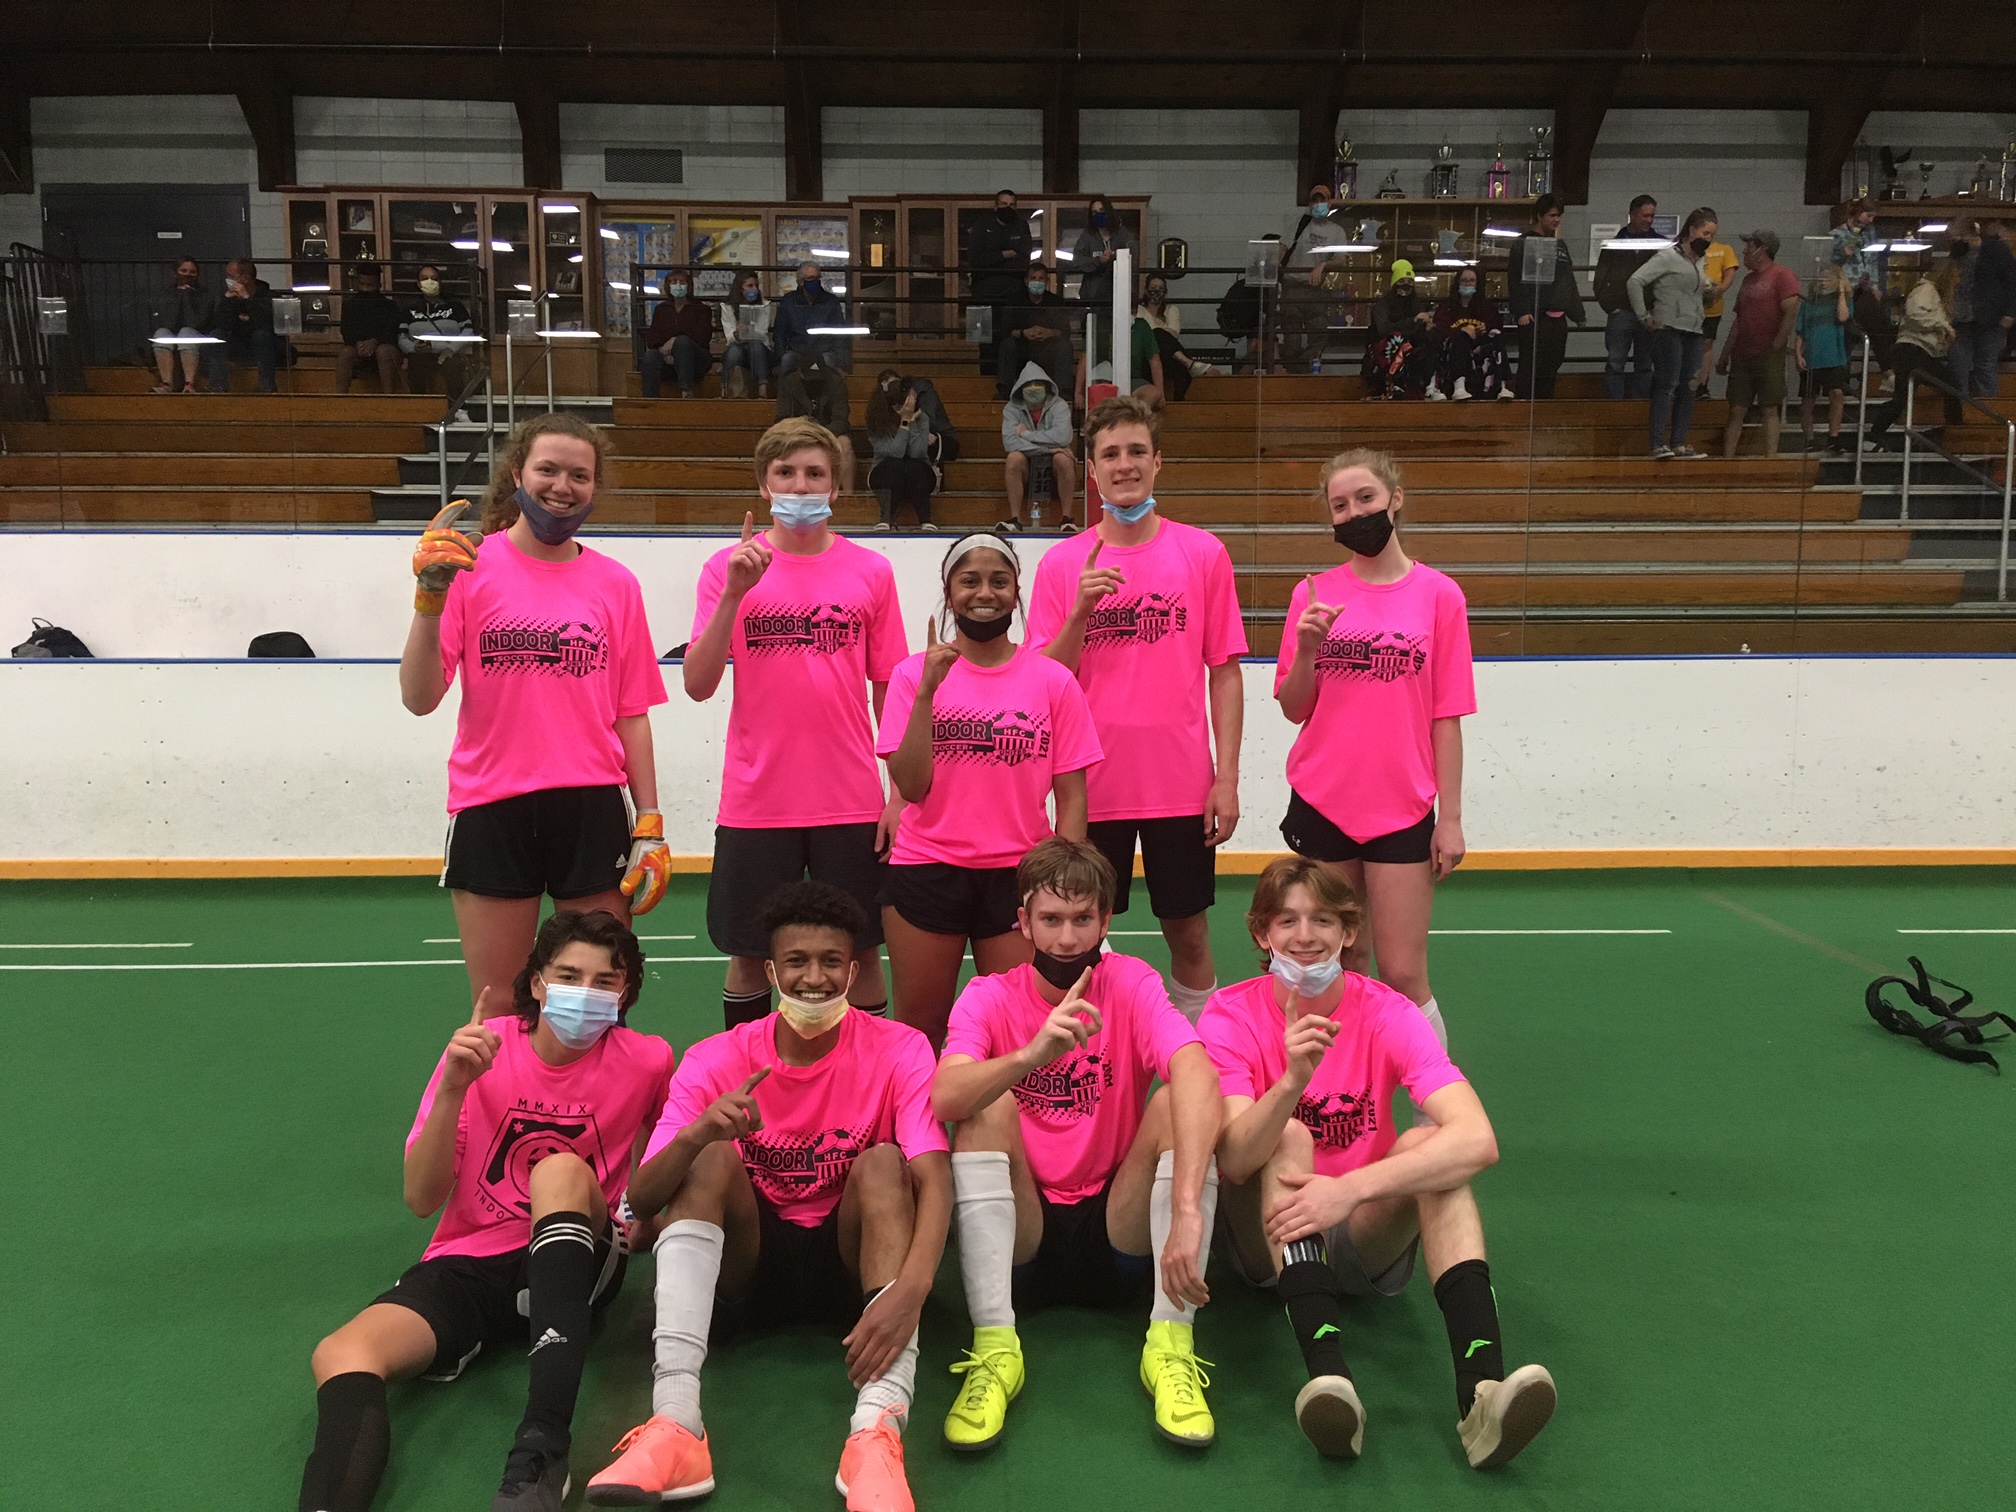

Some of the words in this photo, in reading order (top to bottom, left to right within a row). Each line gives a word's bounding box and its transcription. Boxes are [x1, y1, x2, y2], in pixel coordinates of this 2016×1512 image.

[746, 619, 806, 636] INDOOR
[820, 621, 840, 629] HFC
[1087, 610, 1130, 630] DOOR
[1175, 606, 1187, 632] 2021
[482, 632, 552, 651] INDOOR
[570, 639, 591, 649] HFC
[1315, 641, 1365, 659] DOOR
[497, 654, 535, 662] SOCCER
[1380, 648, 1401, 656] HFC
[932, 721, 986, 740] DOOR
[1003, 728, 1026, 737] HFC
[933, 744, 969, 752] SOCCER
[1038, 729, 1051, 758] 2021
[518, 1098, 587, 1114] MMXIX
[1330, 1114, 1353, 1123] HFC
[1368, 1100, 1378, 1131] 2021
[742, 1143, 807, 1170] NDOOR
[824, 1151, 847, 1161] HFC
[475, 1189, 505, 1219] INDO
